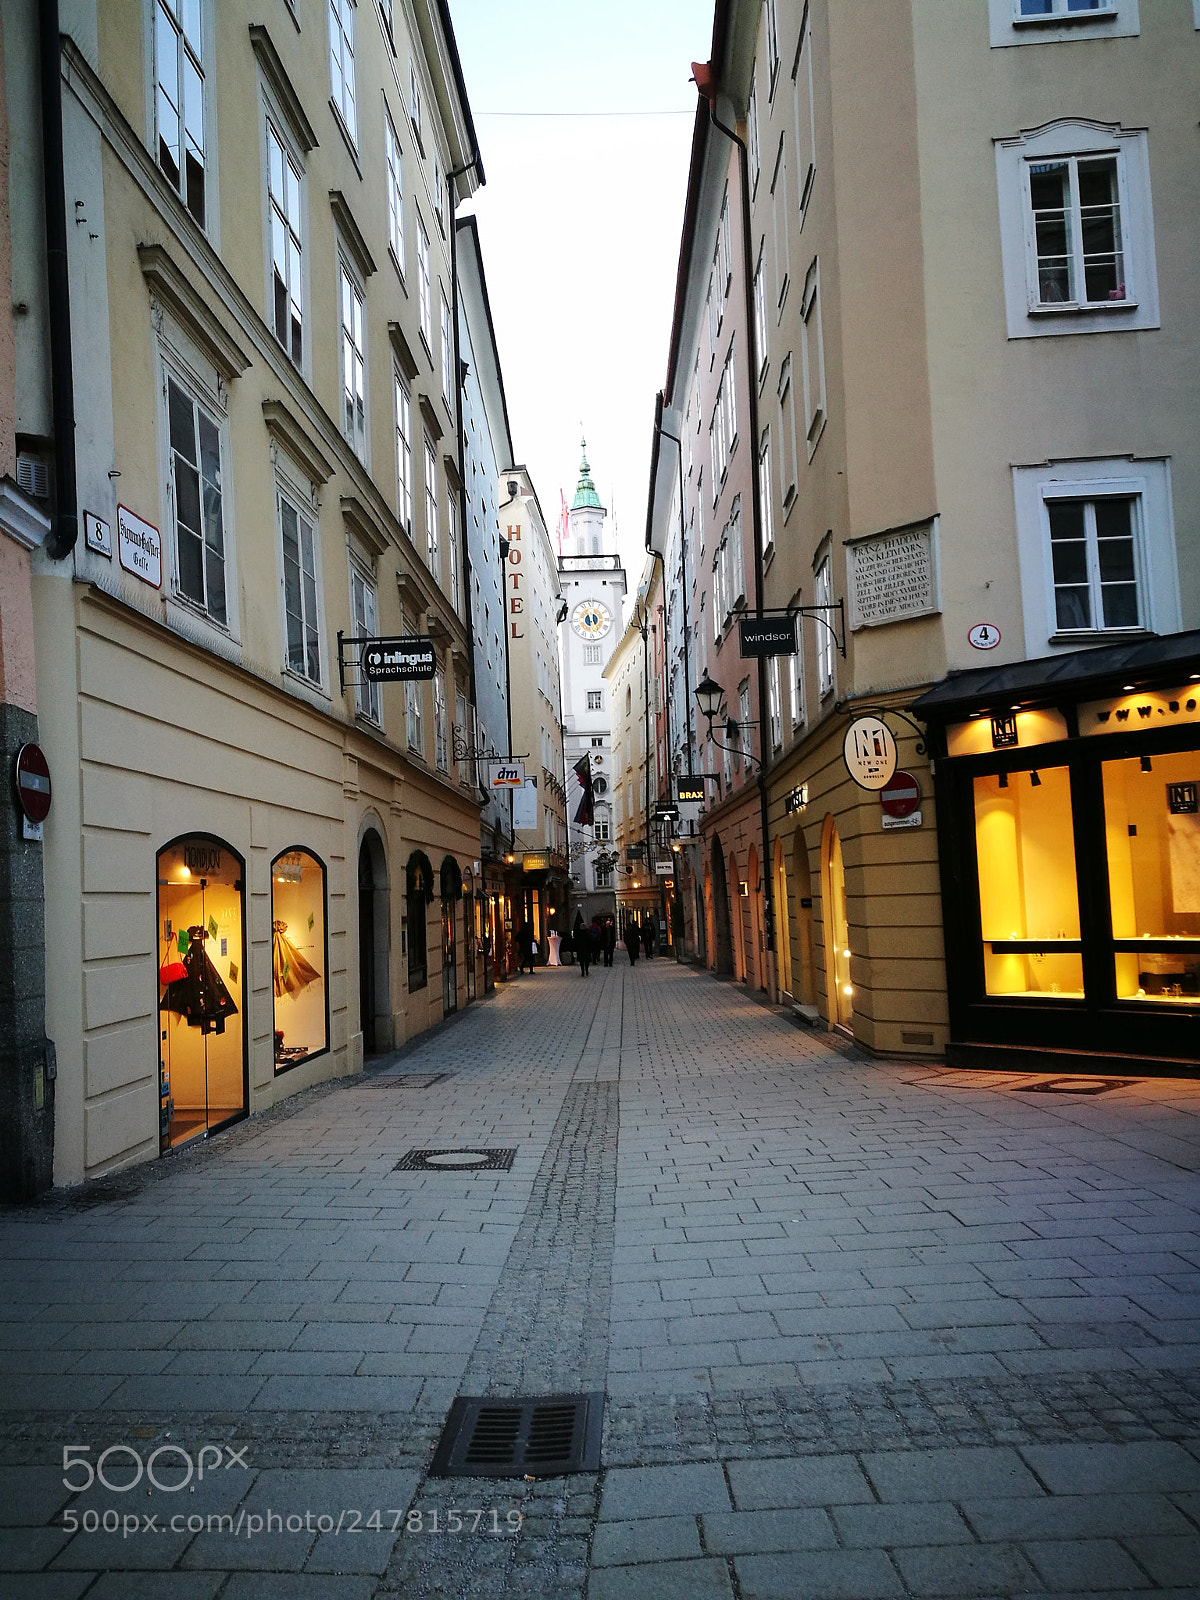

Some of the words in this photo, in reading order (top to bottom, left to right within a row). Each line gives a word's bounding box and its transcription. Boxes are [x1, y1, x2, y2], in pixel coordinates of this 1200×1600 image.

[95, 522, 103, 541] 8
[853, 544, 881, 558] FRANZ
[857, 555, 874, 565] VON
[507, 525, 525, 639] HOTEL
[744, 632, 792, 642] windsor.
[979, 626, 989, 640] 4
[383, 651, 433, 666] inlingua
[369, 665, 432, 675] Sprachschule
[498, 768, 518, 779] dm
